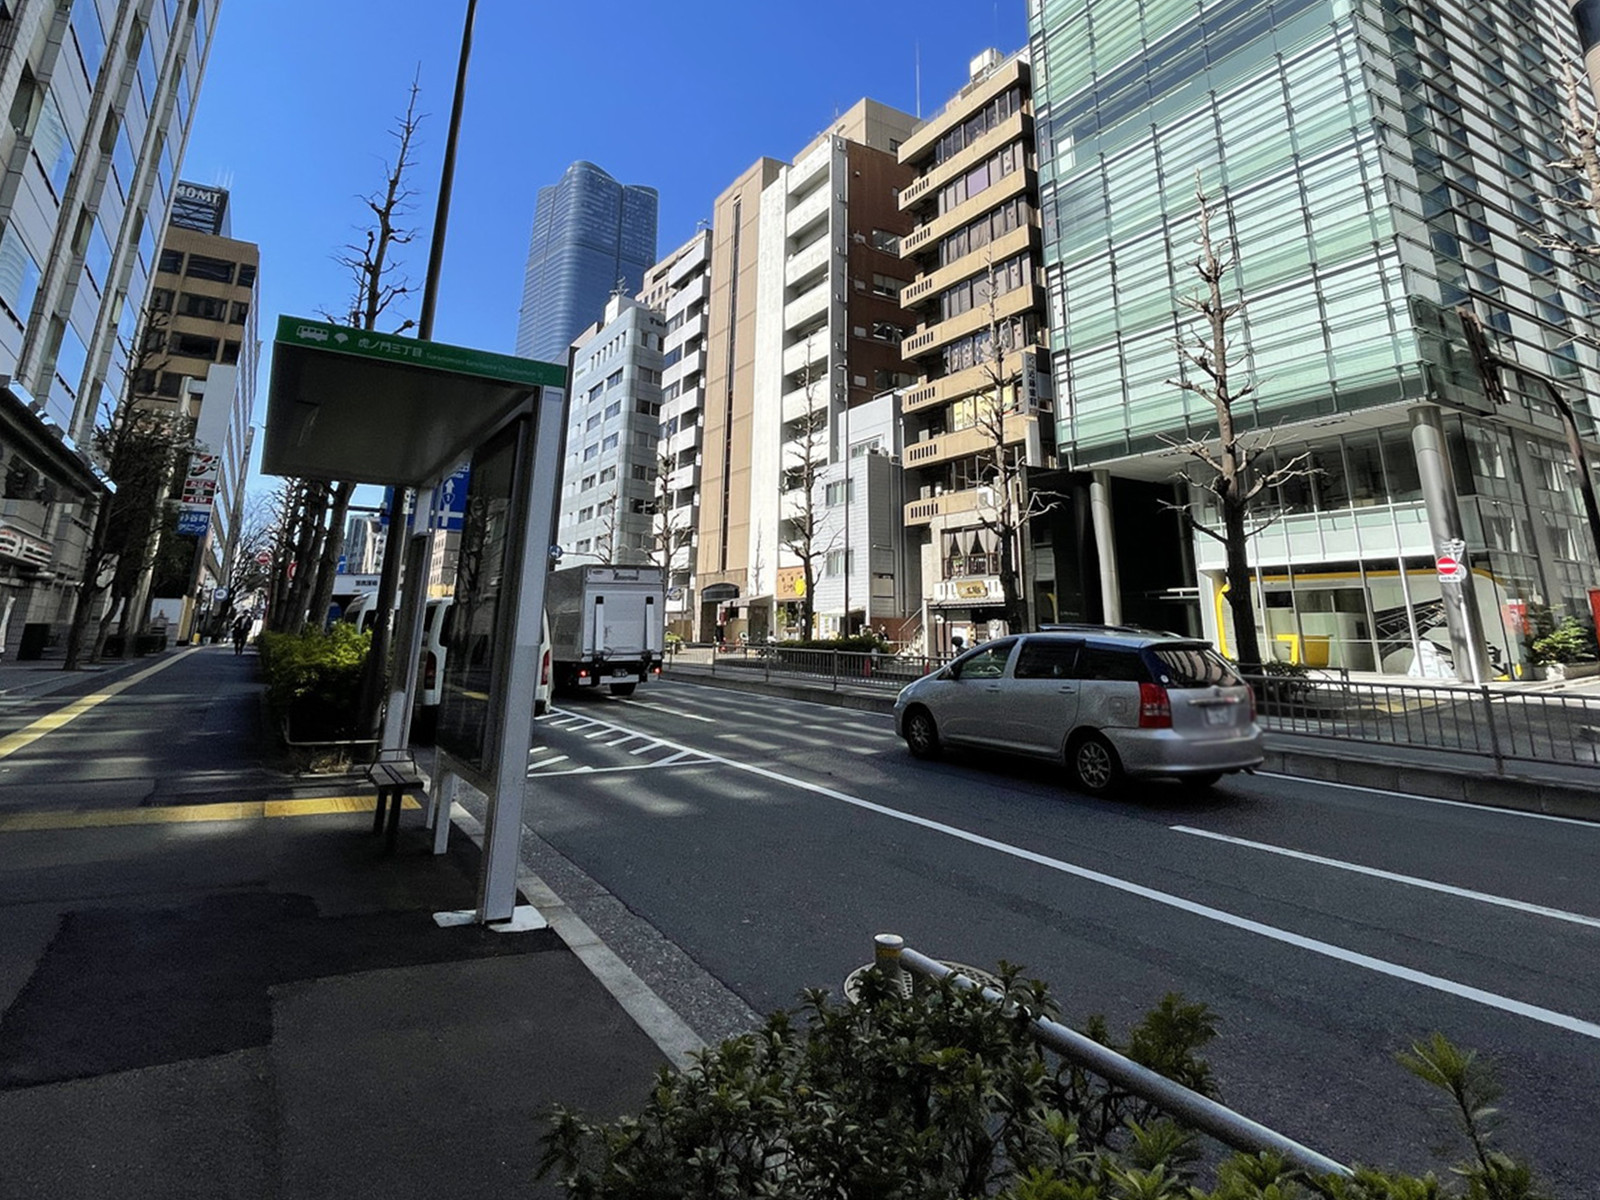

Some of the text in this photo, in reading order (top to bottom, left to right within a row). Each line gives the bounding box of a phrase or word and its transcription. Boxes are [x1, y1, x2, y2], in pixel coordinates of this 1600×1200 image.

[357, 337, 423, 358] 虎ノ門三丁目
